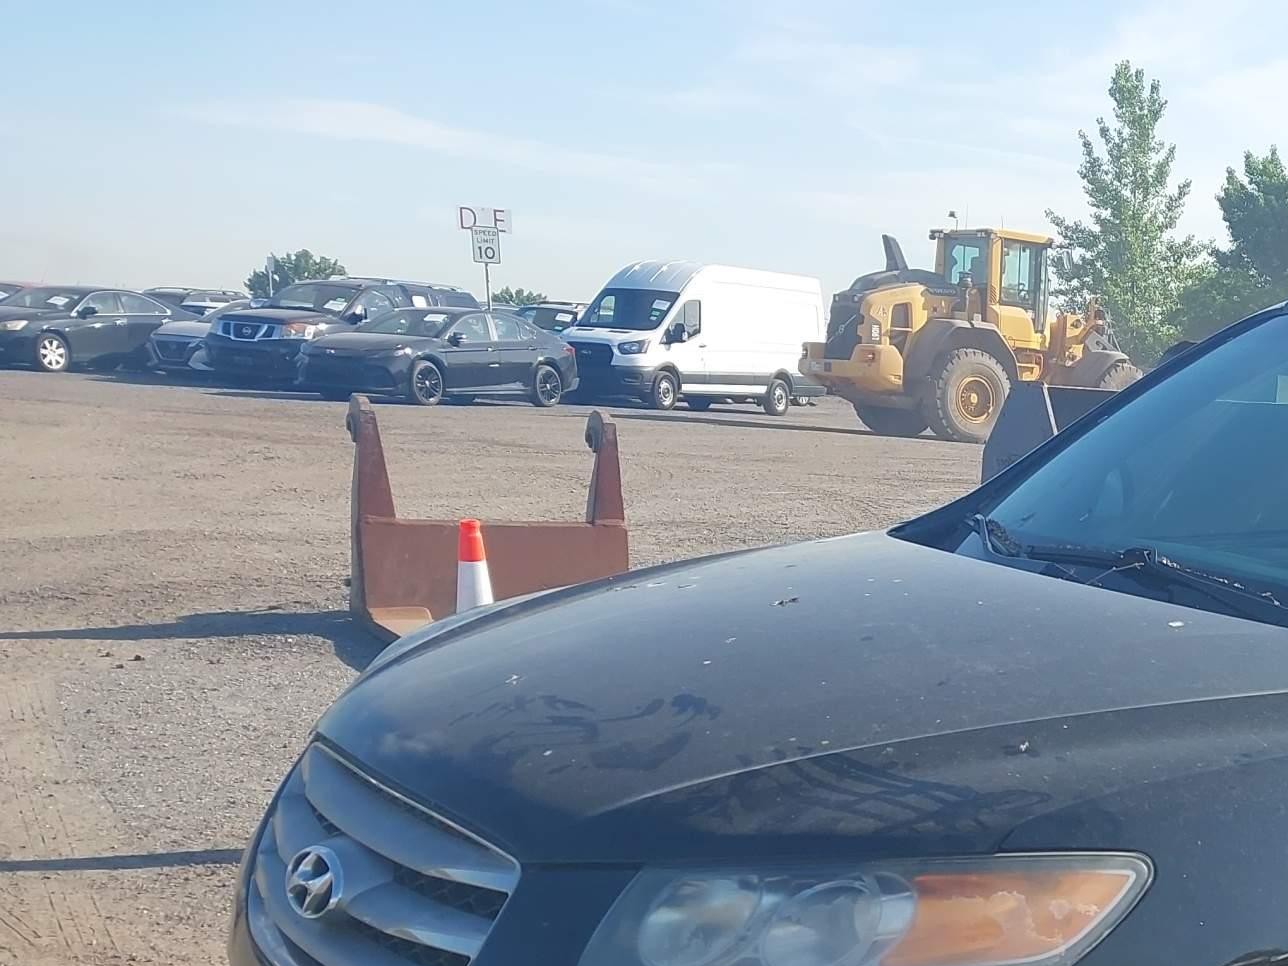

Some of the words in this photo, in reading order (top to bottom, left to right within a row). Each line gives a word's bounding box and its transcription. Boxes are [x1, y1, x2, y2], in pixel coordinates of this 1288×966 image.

[459, 206, 477, 229] D
[474, 229, 497, 237] SPEED
[476, 237, 495, 245] LIMIT
[477, 246, 496, 260] 10
